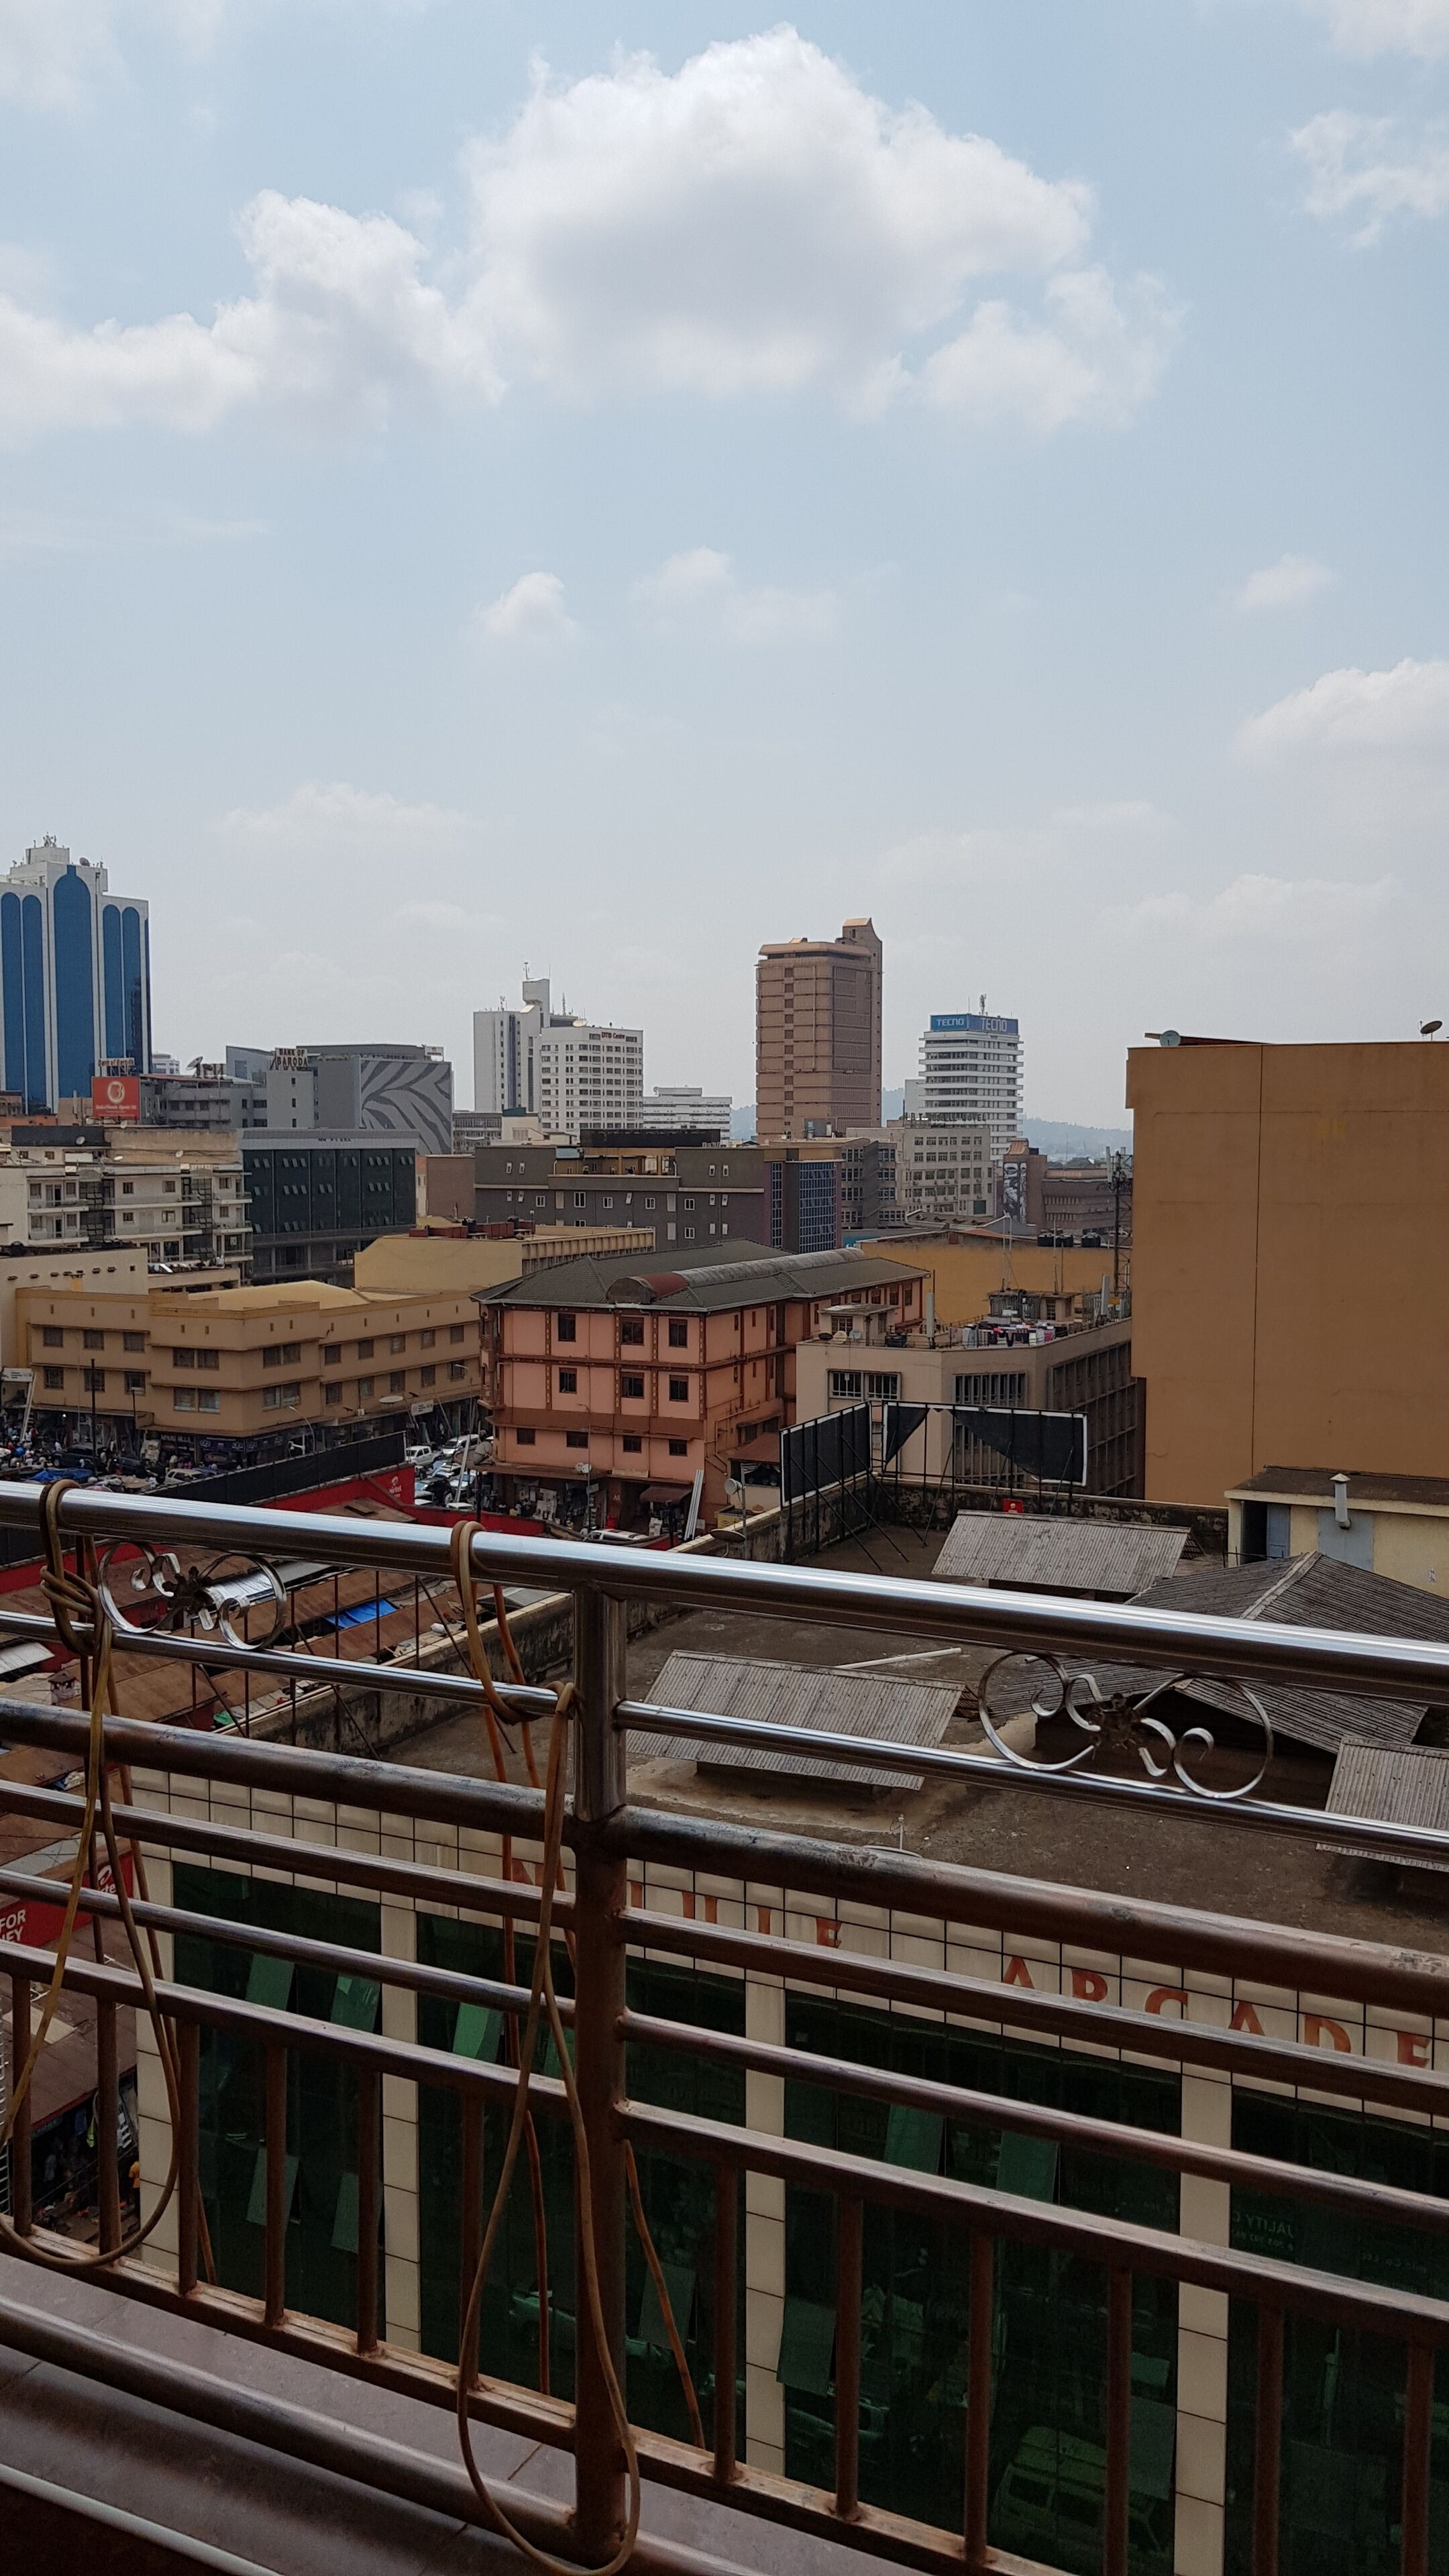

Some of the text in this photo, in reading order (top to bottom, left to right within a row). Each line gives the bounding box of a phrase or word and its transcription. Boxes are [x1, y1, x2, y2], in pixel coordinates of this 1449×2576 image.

[936, 1018, 964, 1027] TECNO
[981, 1018, 1007, 1032] TECNO
[277, 1057, 307, 1067] BARODA
[0, 1909, 26, 1932] FOR
[1002, 1955, 1430, 2068] ARCADE
